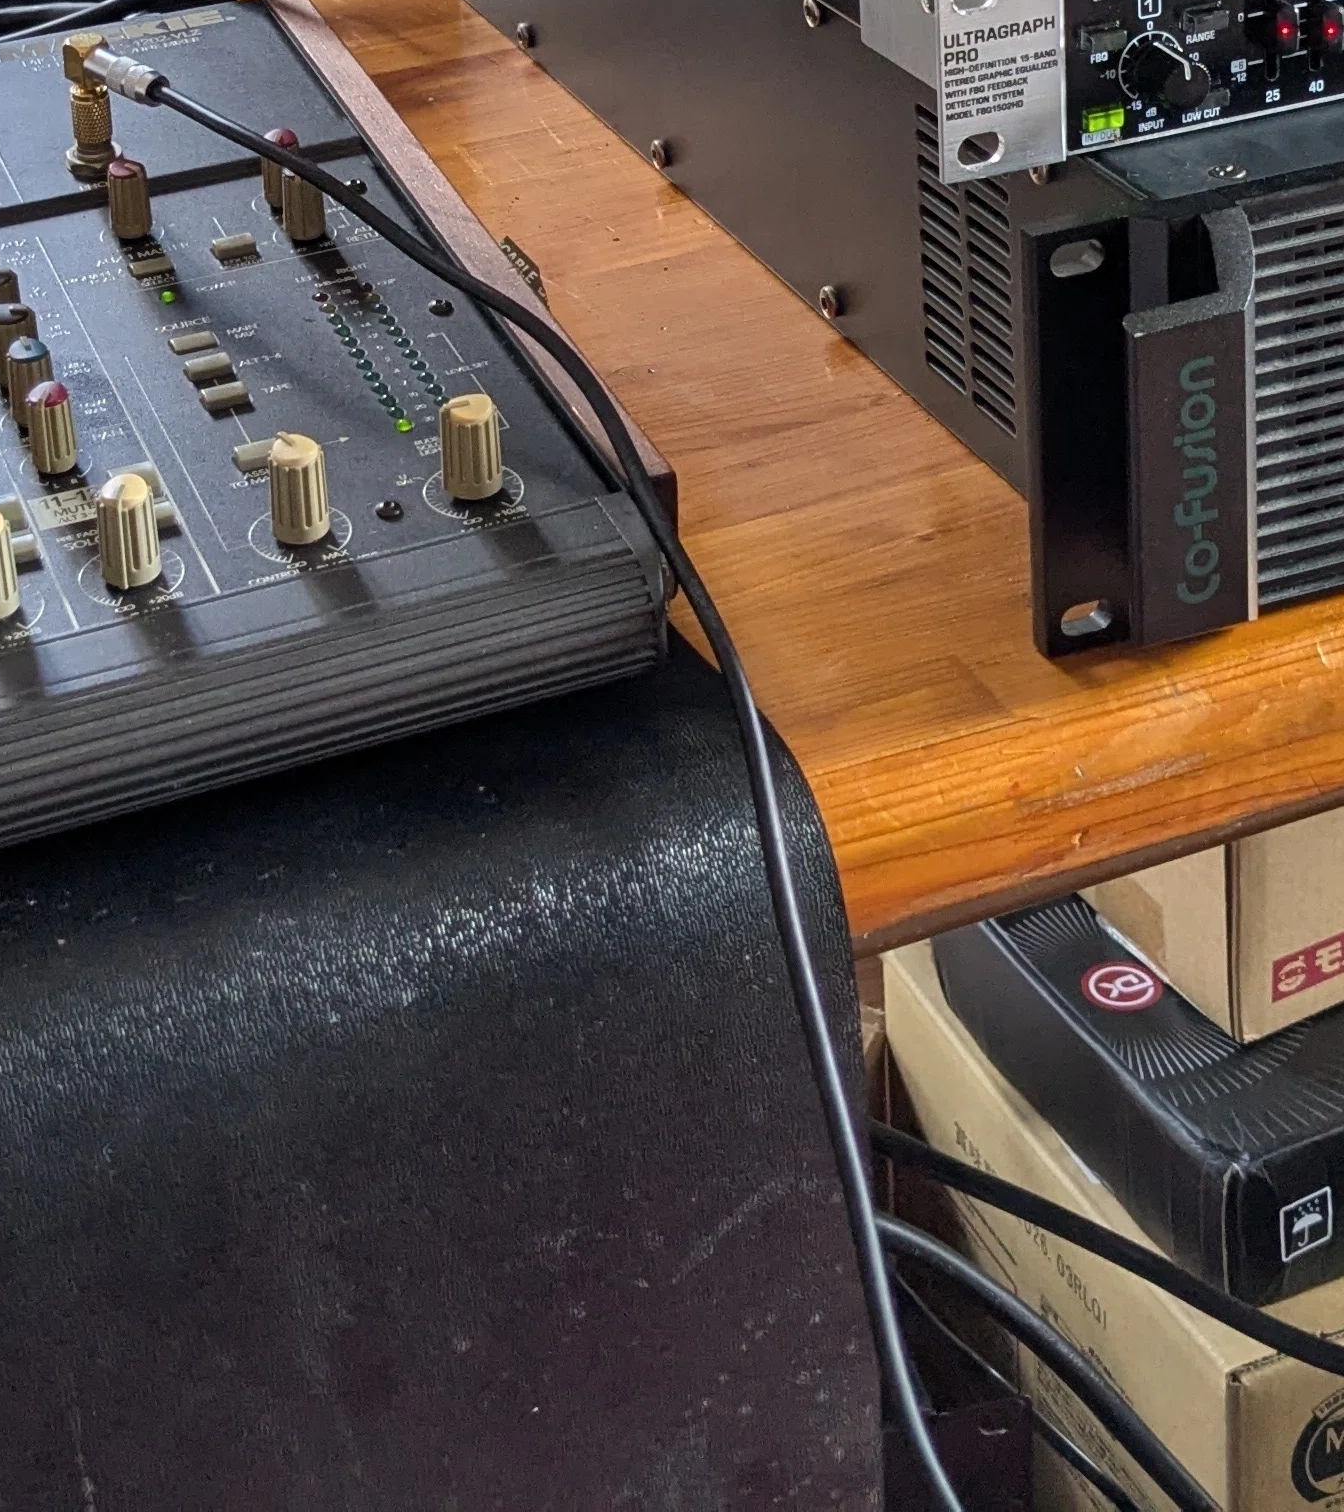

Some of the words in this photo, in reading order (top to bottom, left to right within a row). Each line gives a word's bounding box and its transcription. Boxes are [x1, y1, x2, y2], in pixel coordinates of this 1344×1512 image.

[943, 15, 1056, 49] ULTRAGRAPH
[1186, 30, 1216, 45] RANGE
[944, 48, 979, 66] PRO
[944, 57, 1017, 78] HIGH-DEFINITION
[1020, 48, 1057, 64] 15-BAND
[1090, 51, 1108, 64] FBQ
[944, 74, 975, 89] STEREO
[977, 68, 1013, 84] GRAPHIC
[1014, 59, 1059, 78] EQUALIZER
[944, 86, 967, 100] WITH
[968, 84, 986, 96] FBQ
[987, 76, 1028, 93] FEEDBACK
[1265, 90, 1281, 103] 25
[1309, 80, 1324, 93] 40
[945, 95, 990, 111] DETECTION
[992, 88, 1024, 103] SYSTEM
[945, 109, 973, 122] MODEL
[975, 100, 1024, 117] FBQ1502HD
[1182, 110, 1200, 123] LOW
[1203, 108, 1221, 121] CUT
[1138, 118, 1164, 133] INPUT
